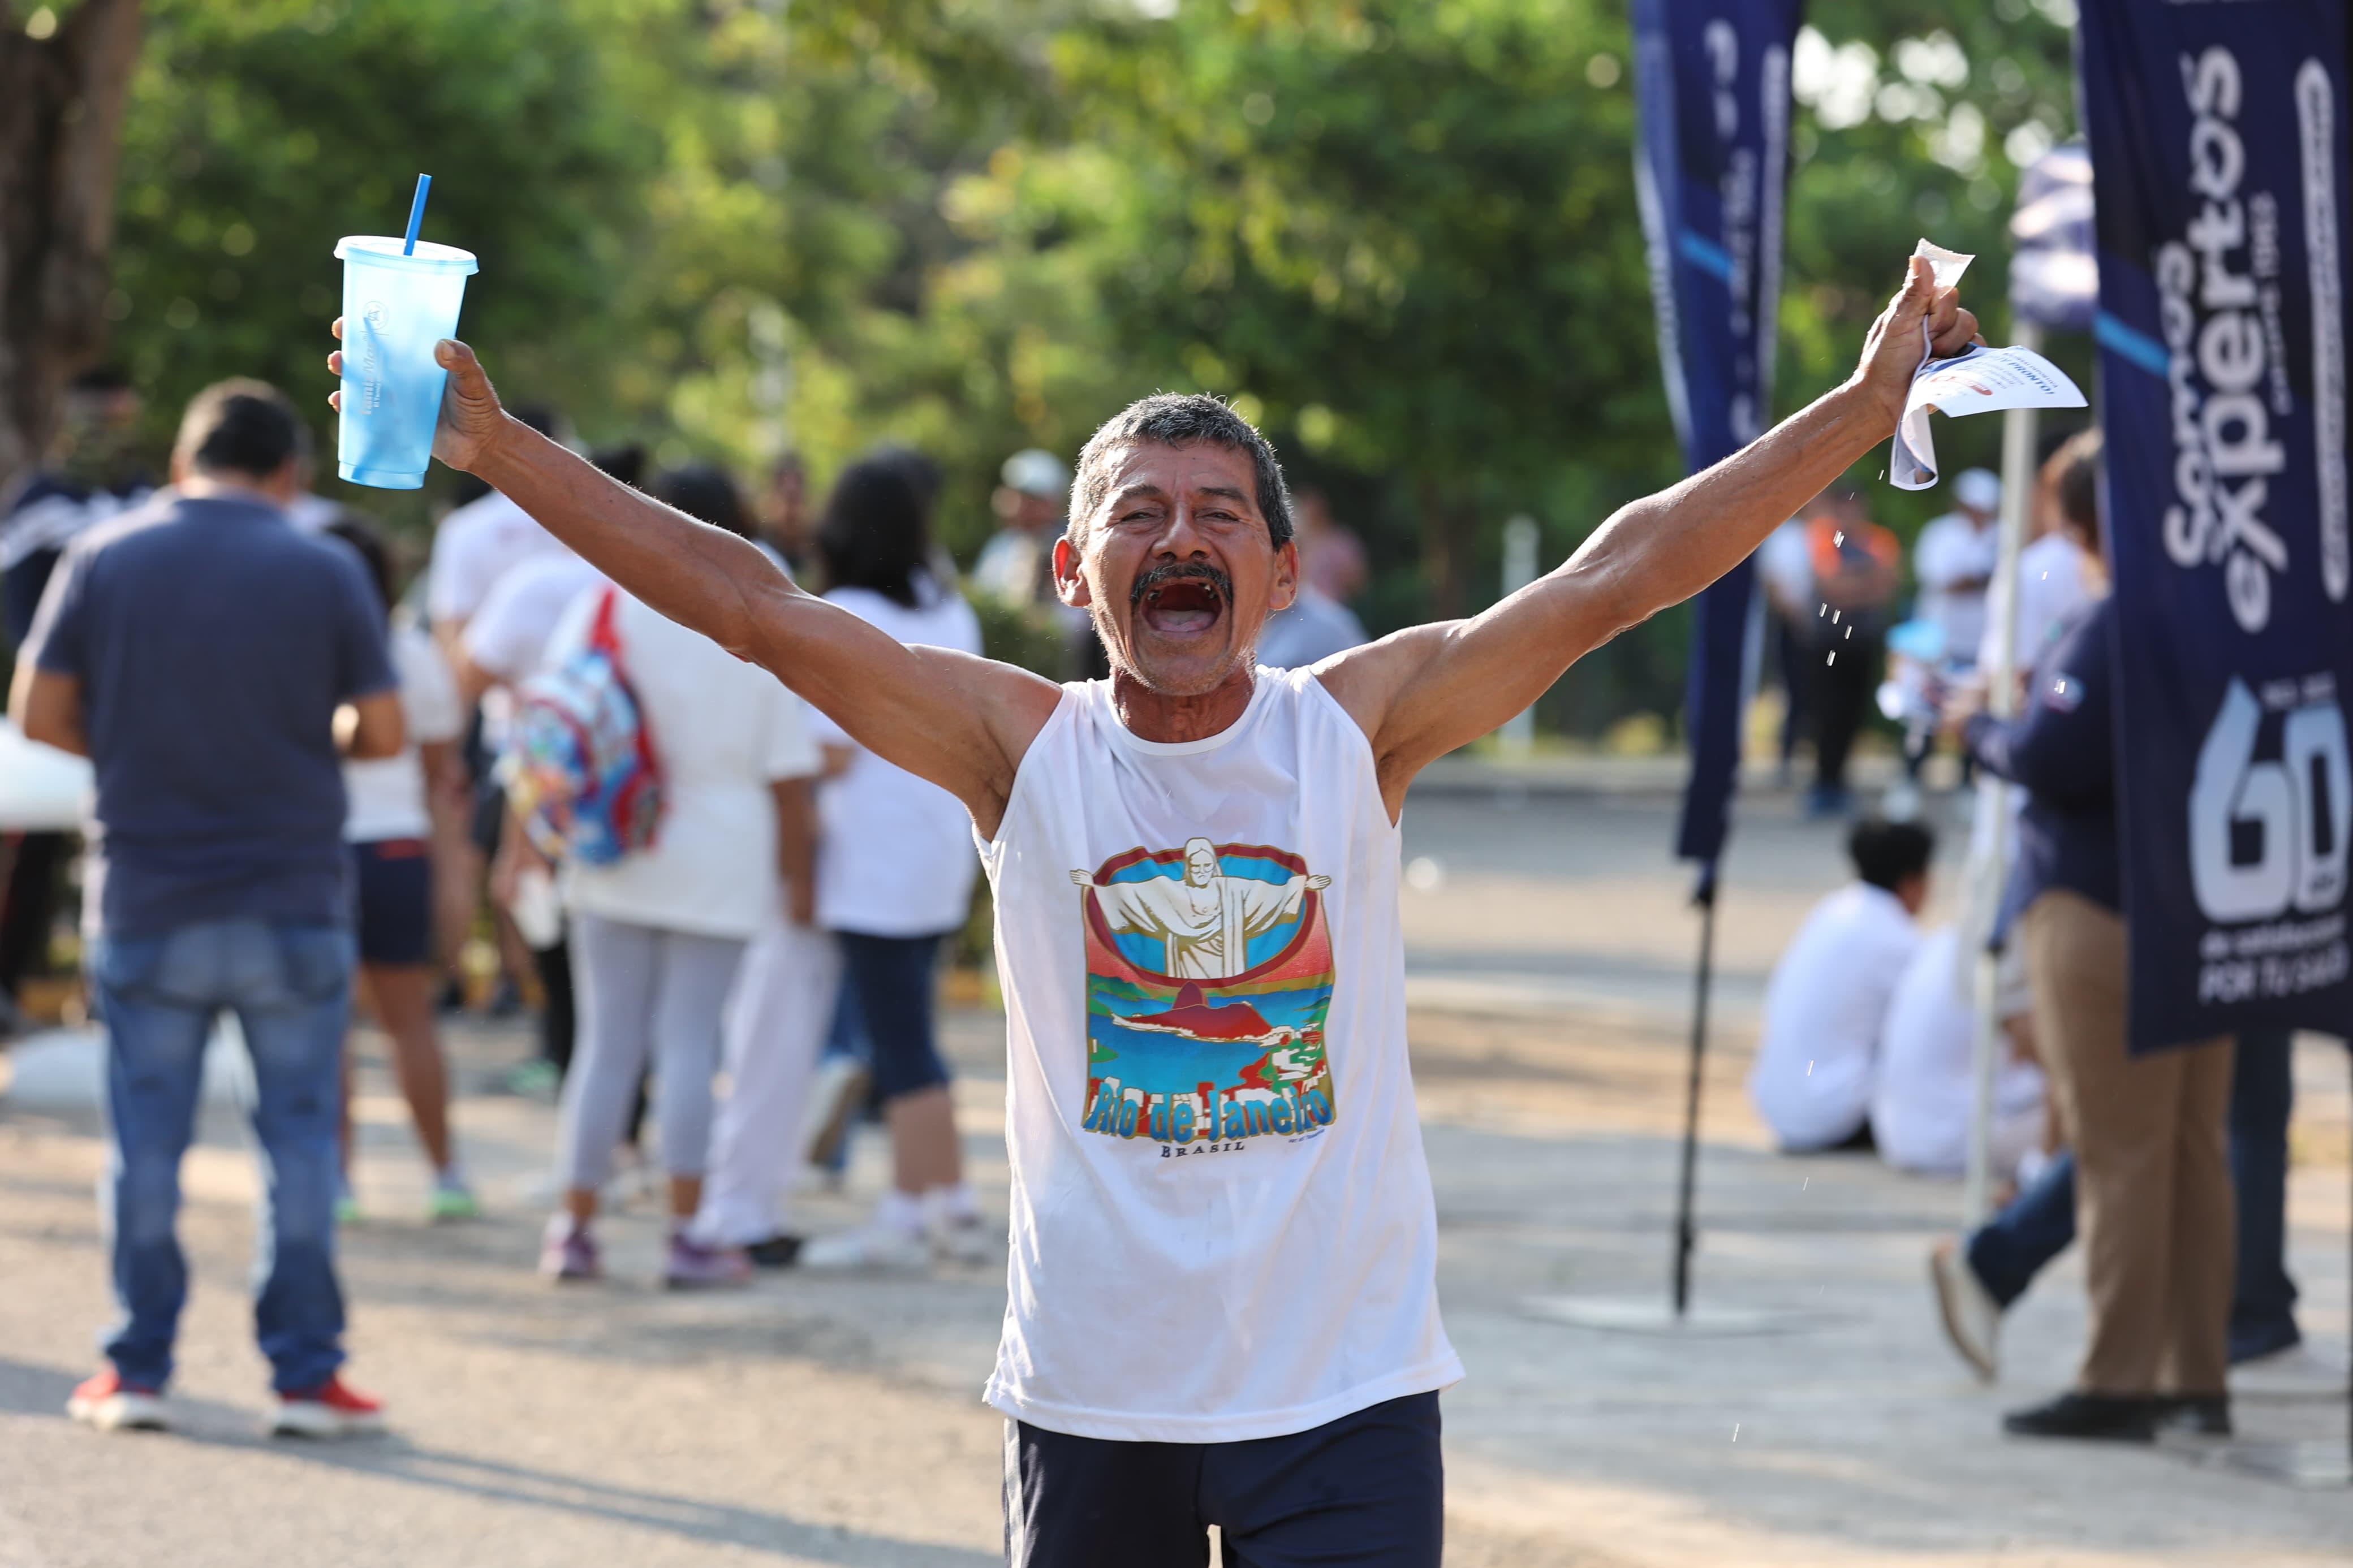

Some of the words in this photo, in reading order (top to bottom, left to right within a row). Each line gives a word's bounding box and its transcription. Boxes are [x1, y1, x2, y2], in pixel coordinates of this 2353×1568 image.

[2158, 242, 2210, 565] Somos
[2189, 675, 2352, 922] 60
[1083, 1081, 1139, 1138] Rio
[1149, 1092, 1196, 1144] de
[1206, 1085, 1334, 1142] Janeiro
[1161, 1141, 1245, 1158] BRASIL
